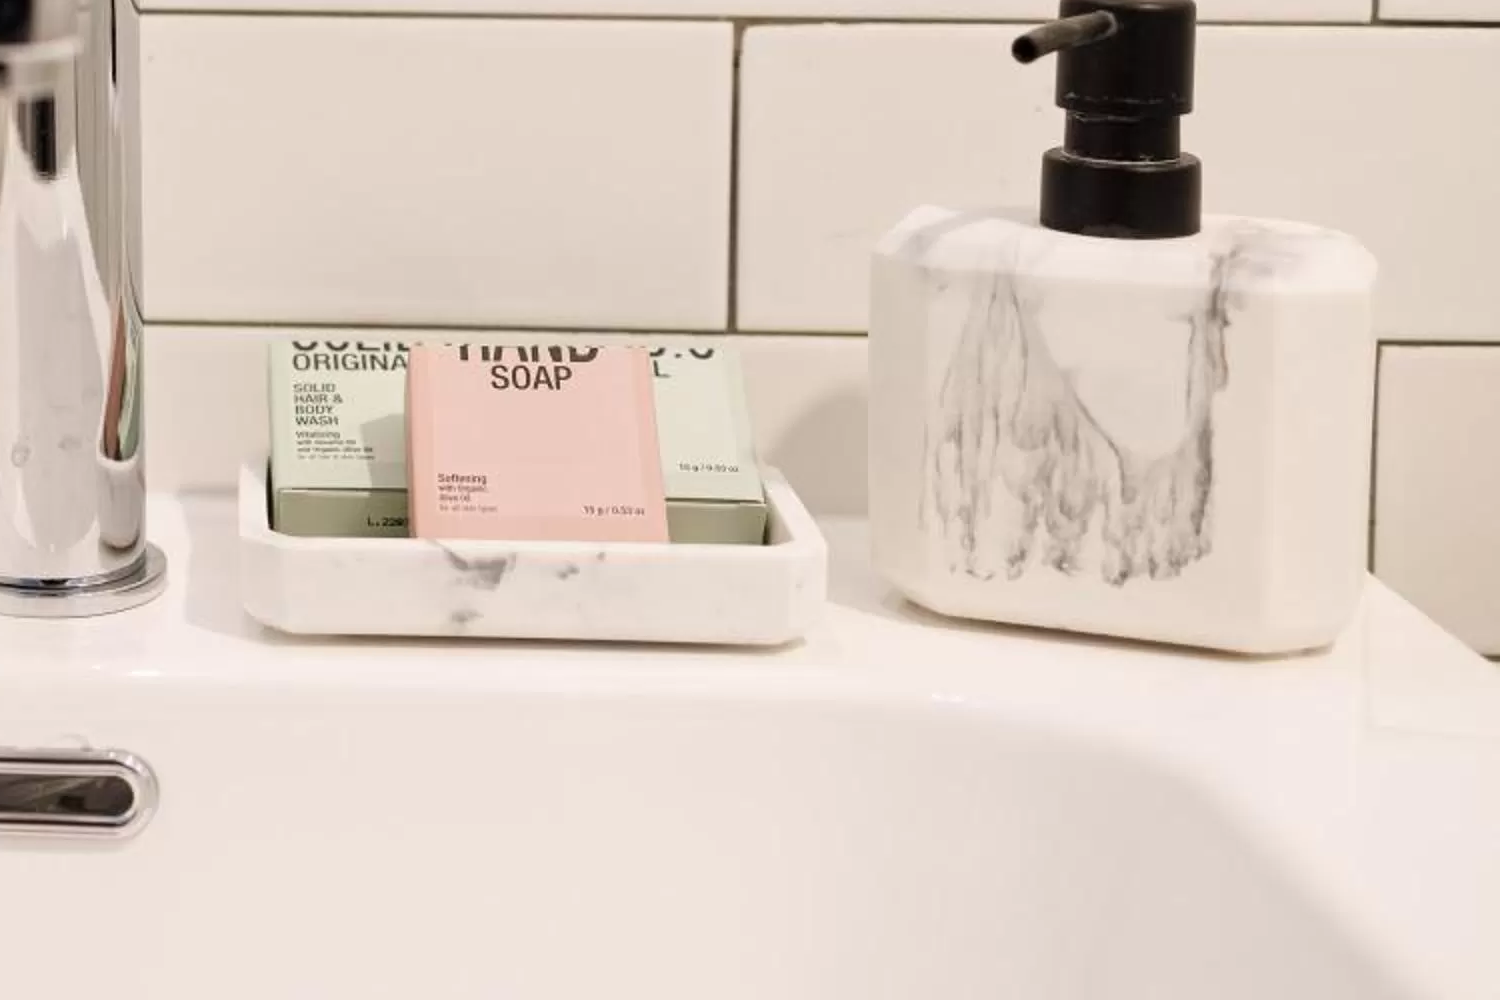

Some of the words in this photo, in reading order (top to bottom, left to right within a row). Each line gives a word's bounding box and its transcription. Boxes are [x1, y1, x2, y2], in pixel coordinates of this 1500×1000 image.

[490, 364, 573, 391] SOAP
[293, 383, 336, 393] SOLID
[294, 393, 329, 403] HAIR
[295, 404, 333, 415] BODY
[295, 415, 339, 426] WASH
[437, 473, 488, 485] Softening
